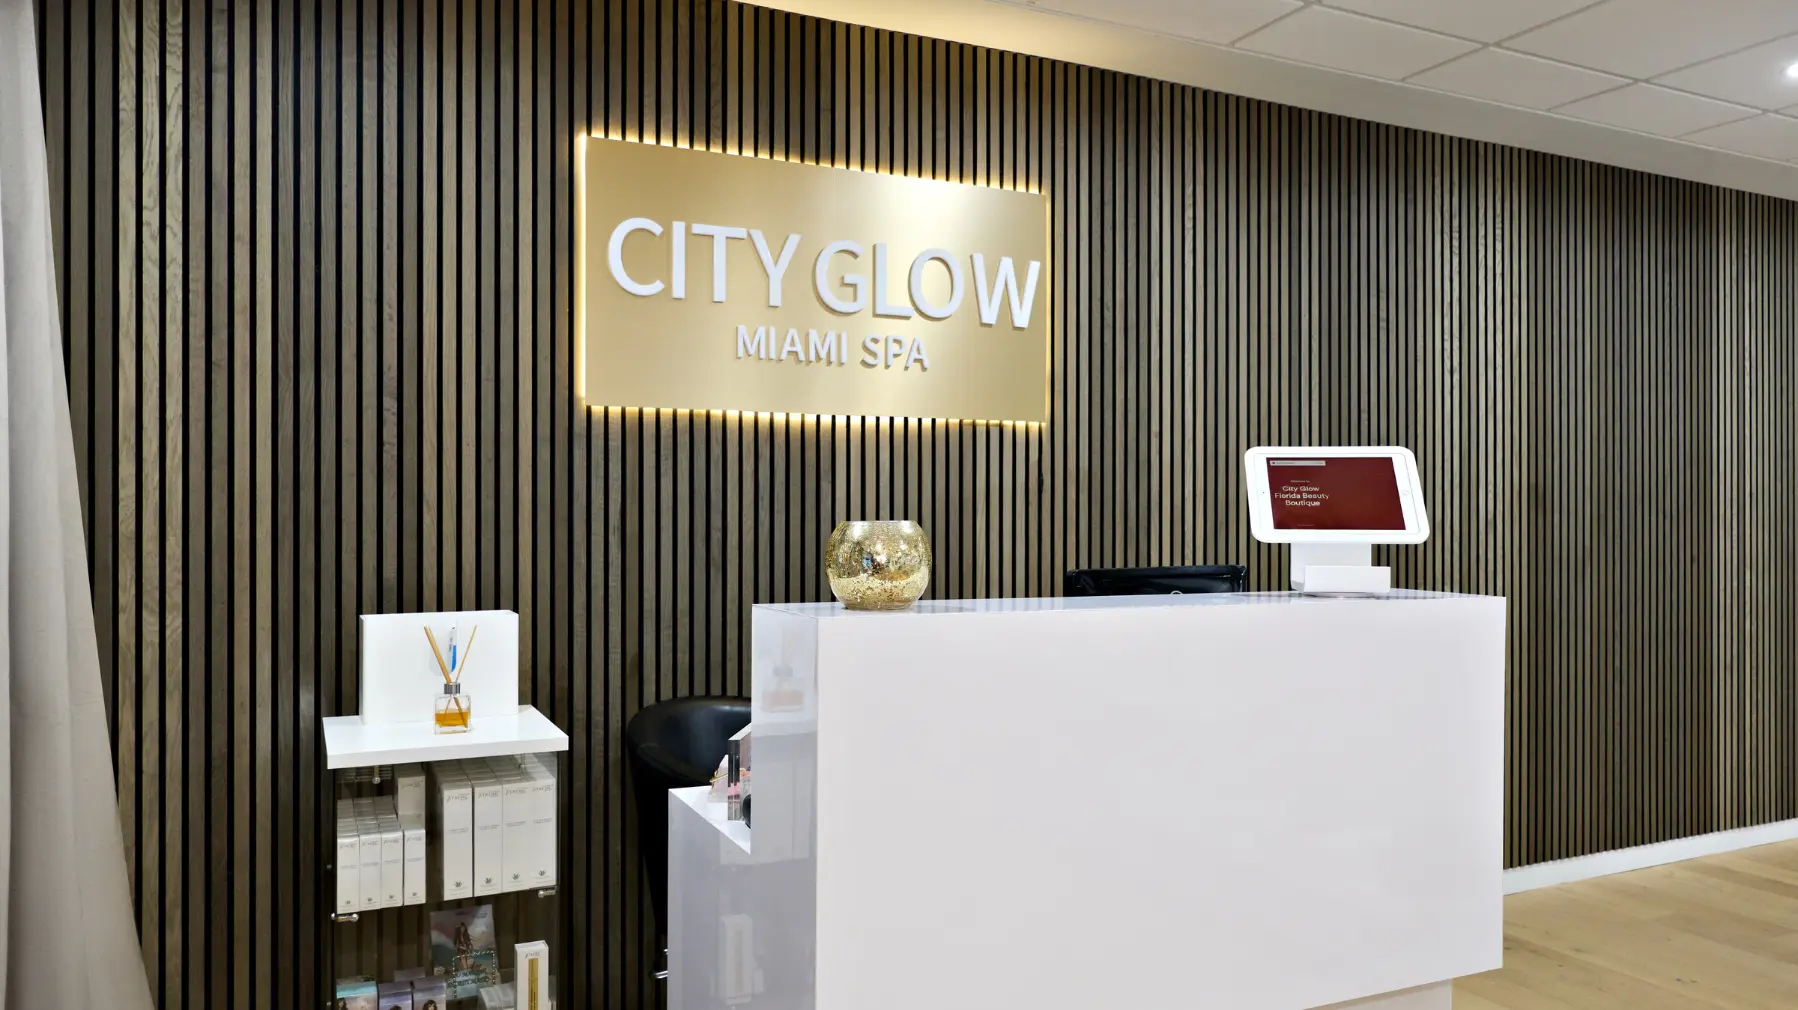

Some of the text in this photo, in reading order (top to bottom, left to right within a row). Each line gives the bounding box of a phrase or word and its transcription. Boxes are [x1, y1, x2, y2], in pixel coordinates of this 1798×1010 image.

[607, 217, 1041, 330] CITY GLOW
[736, 325, 930, 372] MIAMI SPA
[1285, 499, 1321, 507] Boutique
[1302, 492, 1329, 500] Beauty
